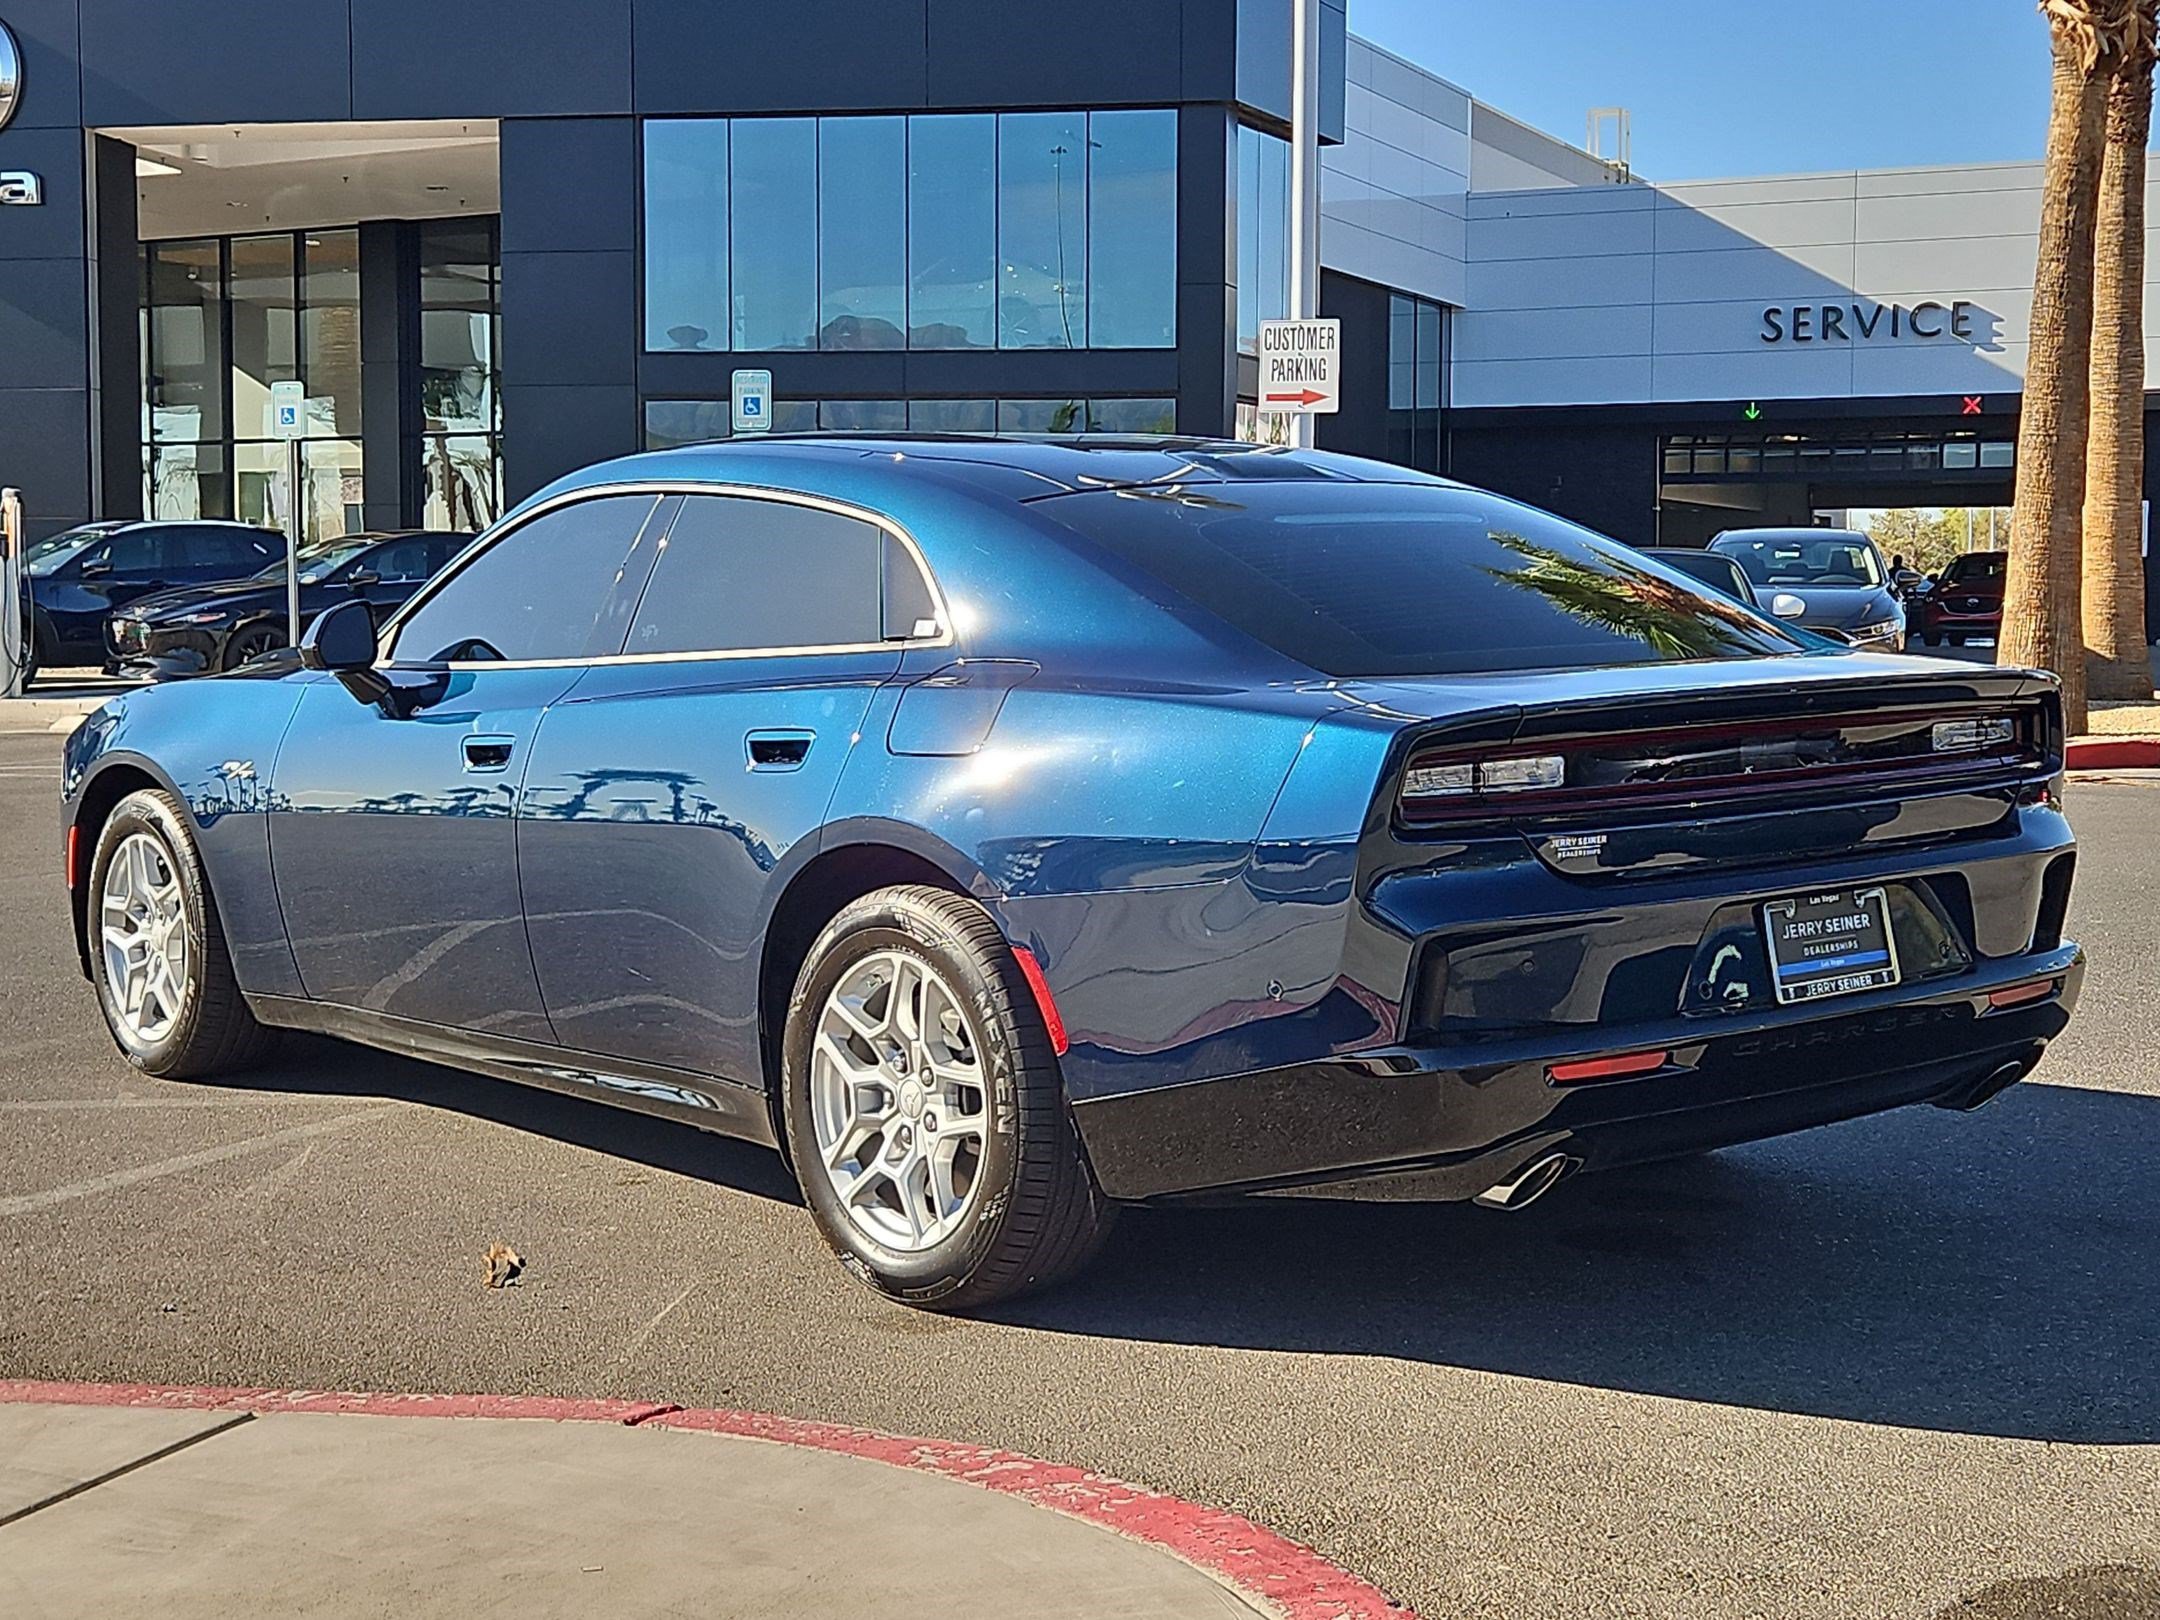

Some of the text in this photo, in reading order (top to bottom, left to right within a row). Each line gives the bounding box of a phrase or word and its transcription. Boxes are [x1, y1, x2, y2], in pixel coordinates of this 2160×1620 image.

[1760, 301, 1973, 343] SERVICE
[1264, 326, 1335, 351] CUSTOMER
[1271, 357, 1327, 382] PARKING
[1550, 835, 1607, 849] JERRY SEINER
[1783, 913, 1871, 939] JERRY SEINER
[1803, 940, 1859, 956] DEALERSHIPS
[1806, 974, 1873, 997] JERRY SEINER
[971, 987, 1015, 1134] NEXEN
